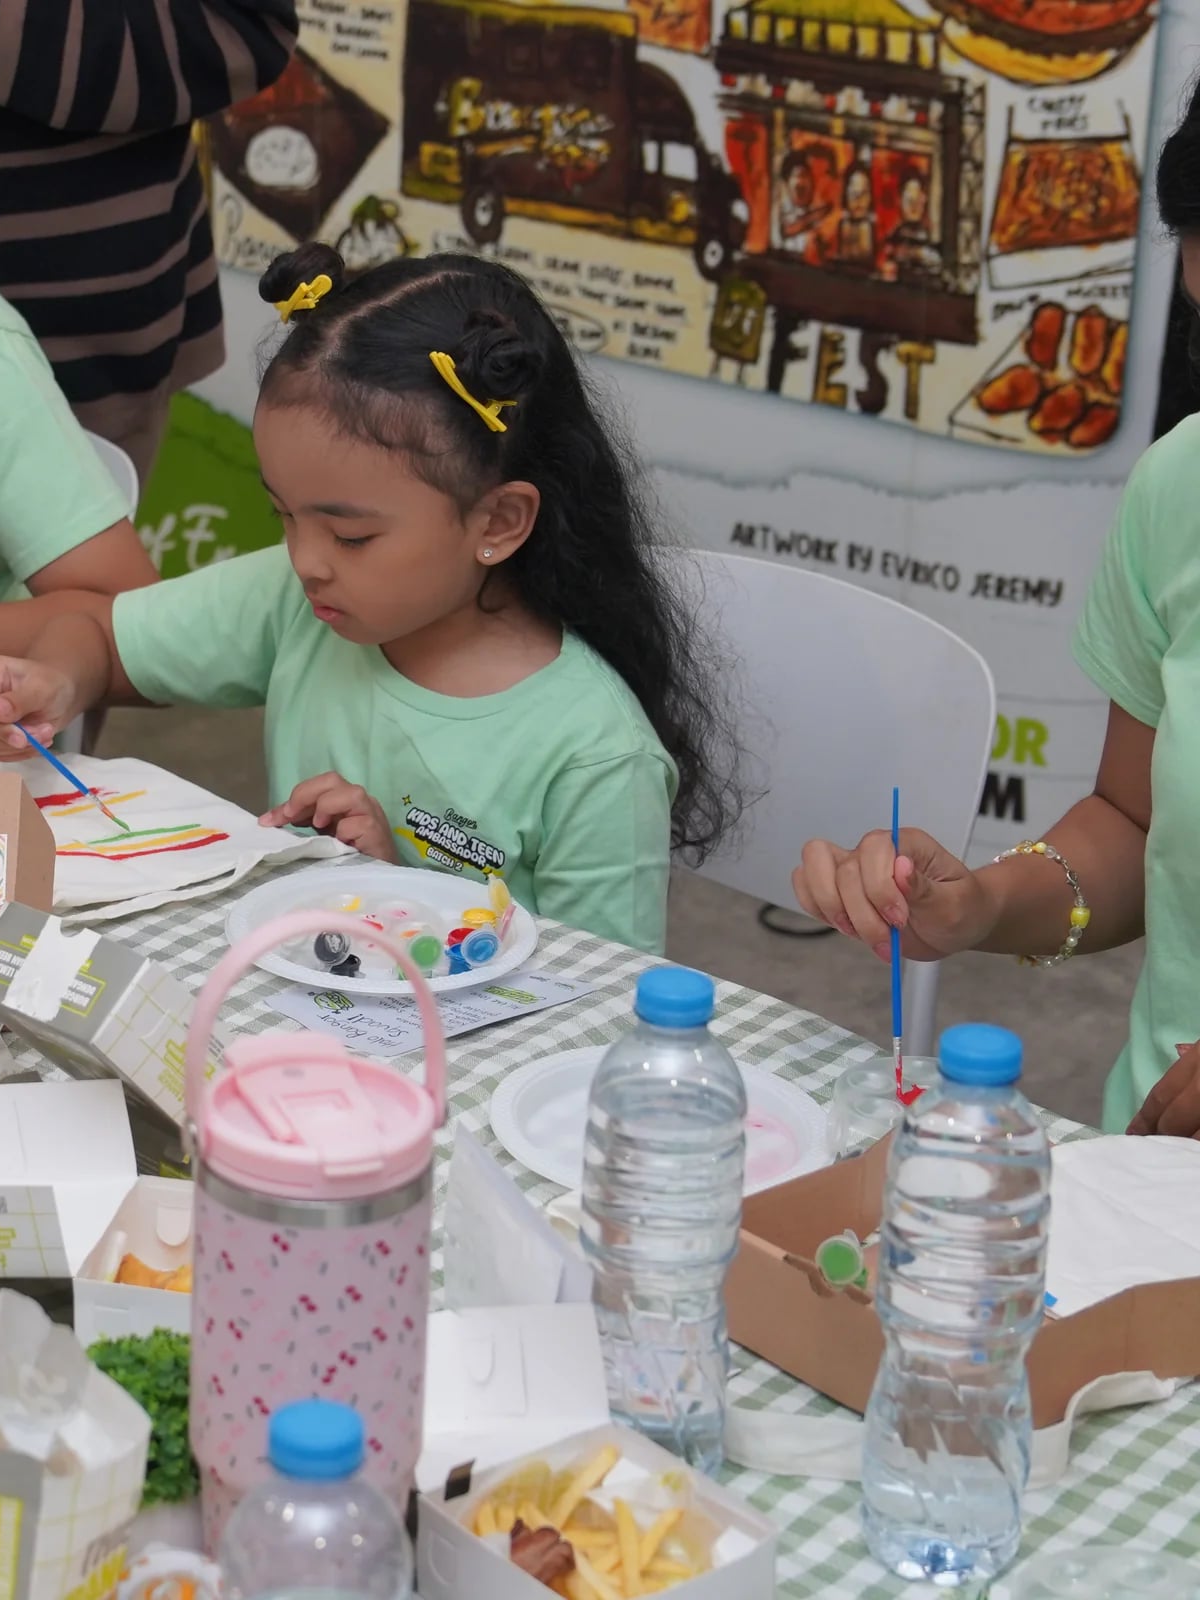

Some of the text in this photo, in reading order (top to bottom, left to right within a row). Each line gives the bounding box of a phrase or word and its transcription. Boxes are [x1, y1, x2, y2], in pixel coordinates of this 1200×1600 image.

[767, 304, 936, 420] FEST
[730, 522, 838, 565] ARTWORK
[847, 543, 873, 573] BY
[970, 573, 1065, 608] JEREMY
[407, 808, 505, 867] KIDS AND TEEN
[444, 808, 478, 829] Bangor
[415, 826, 487, 867] AMBASSADOR
[426, 846, 464, 872] BATCH 2
